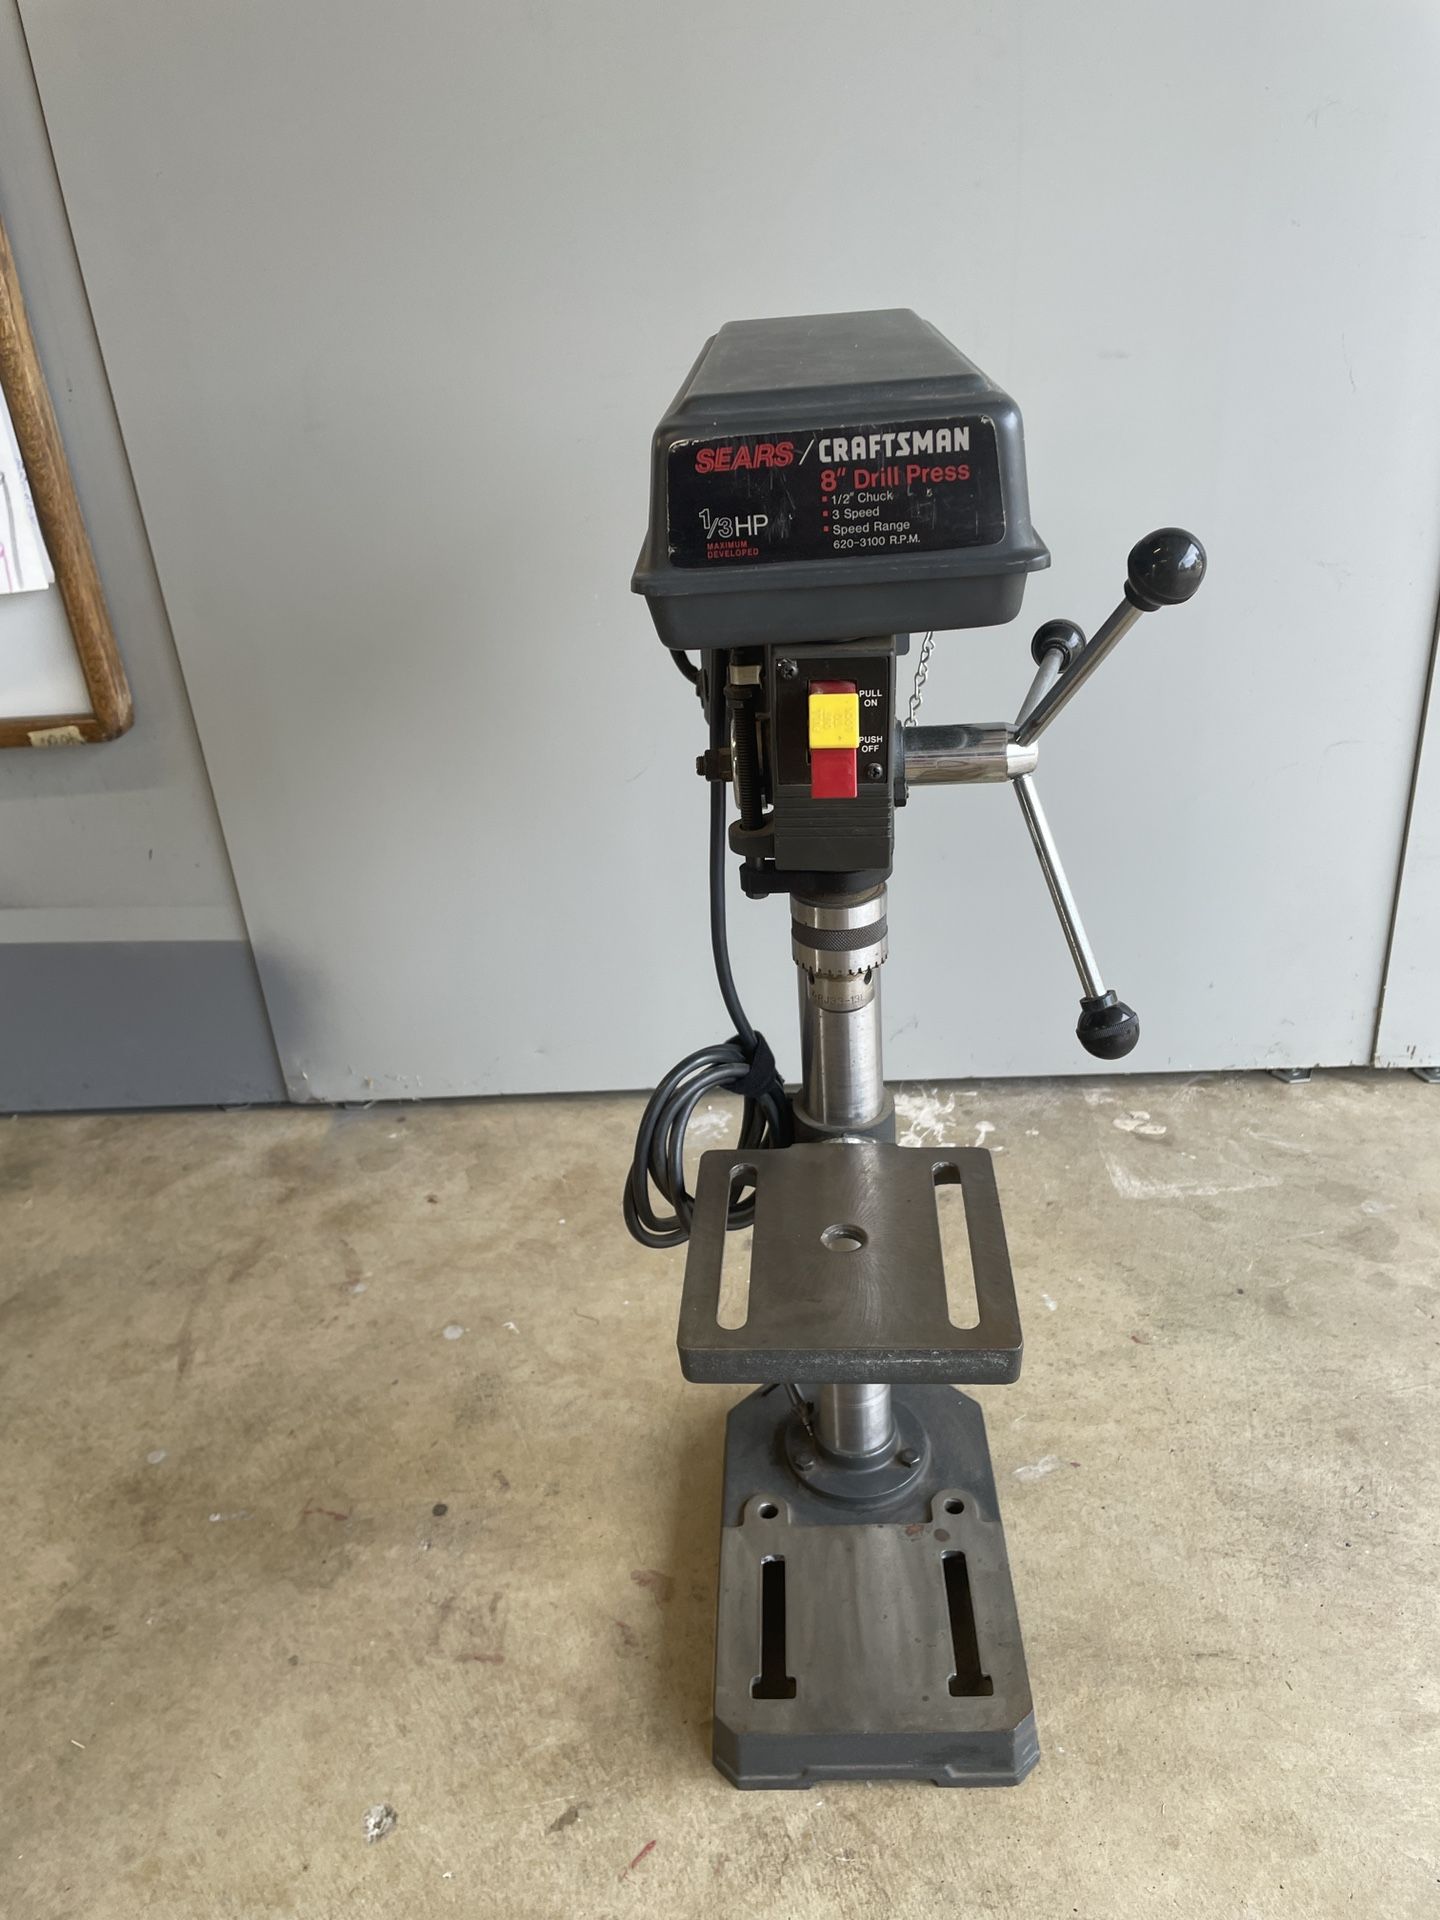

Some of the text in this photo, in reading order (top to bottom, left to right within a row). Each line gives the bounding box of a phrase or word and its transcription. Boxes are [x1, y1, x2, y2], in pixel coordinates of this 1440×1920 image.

[695, 442, 794, 474] SEARS
[819, 427, 970, 463] CRAFTSMAN
[820, 463, 970, 492] 8" Drill Press
[831, 490, 894, 505] 1/2" Chuck
[832, 506, 880, 520] 3 Speed
[832, 520, 910, 536] Speed Range
[706, 541, 748, 550] MAXIMUM
[833, 533, 921, 549] 620-3100 R.P.M.
[707, 548, 759, 559] DEVELOPED
[859, 689, 883, 698] PULL
[863, 698, 878, 707] ON
[858, 735, 883, 744] PUSH
[861, 744, 879, 753] OFF
